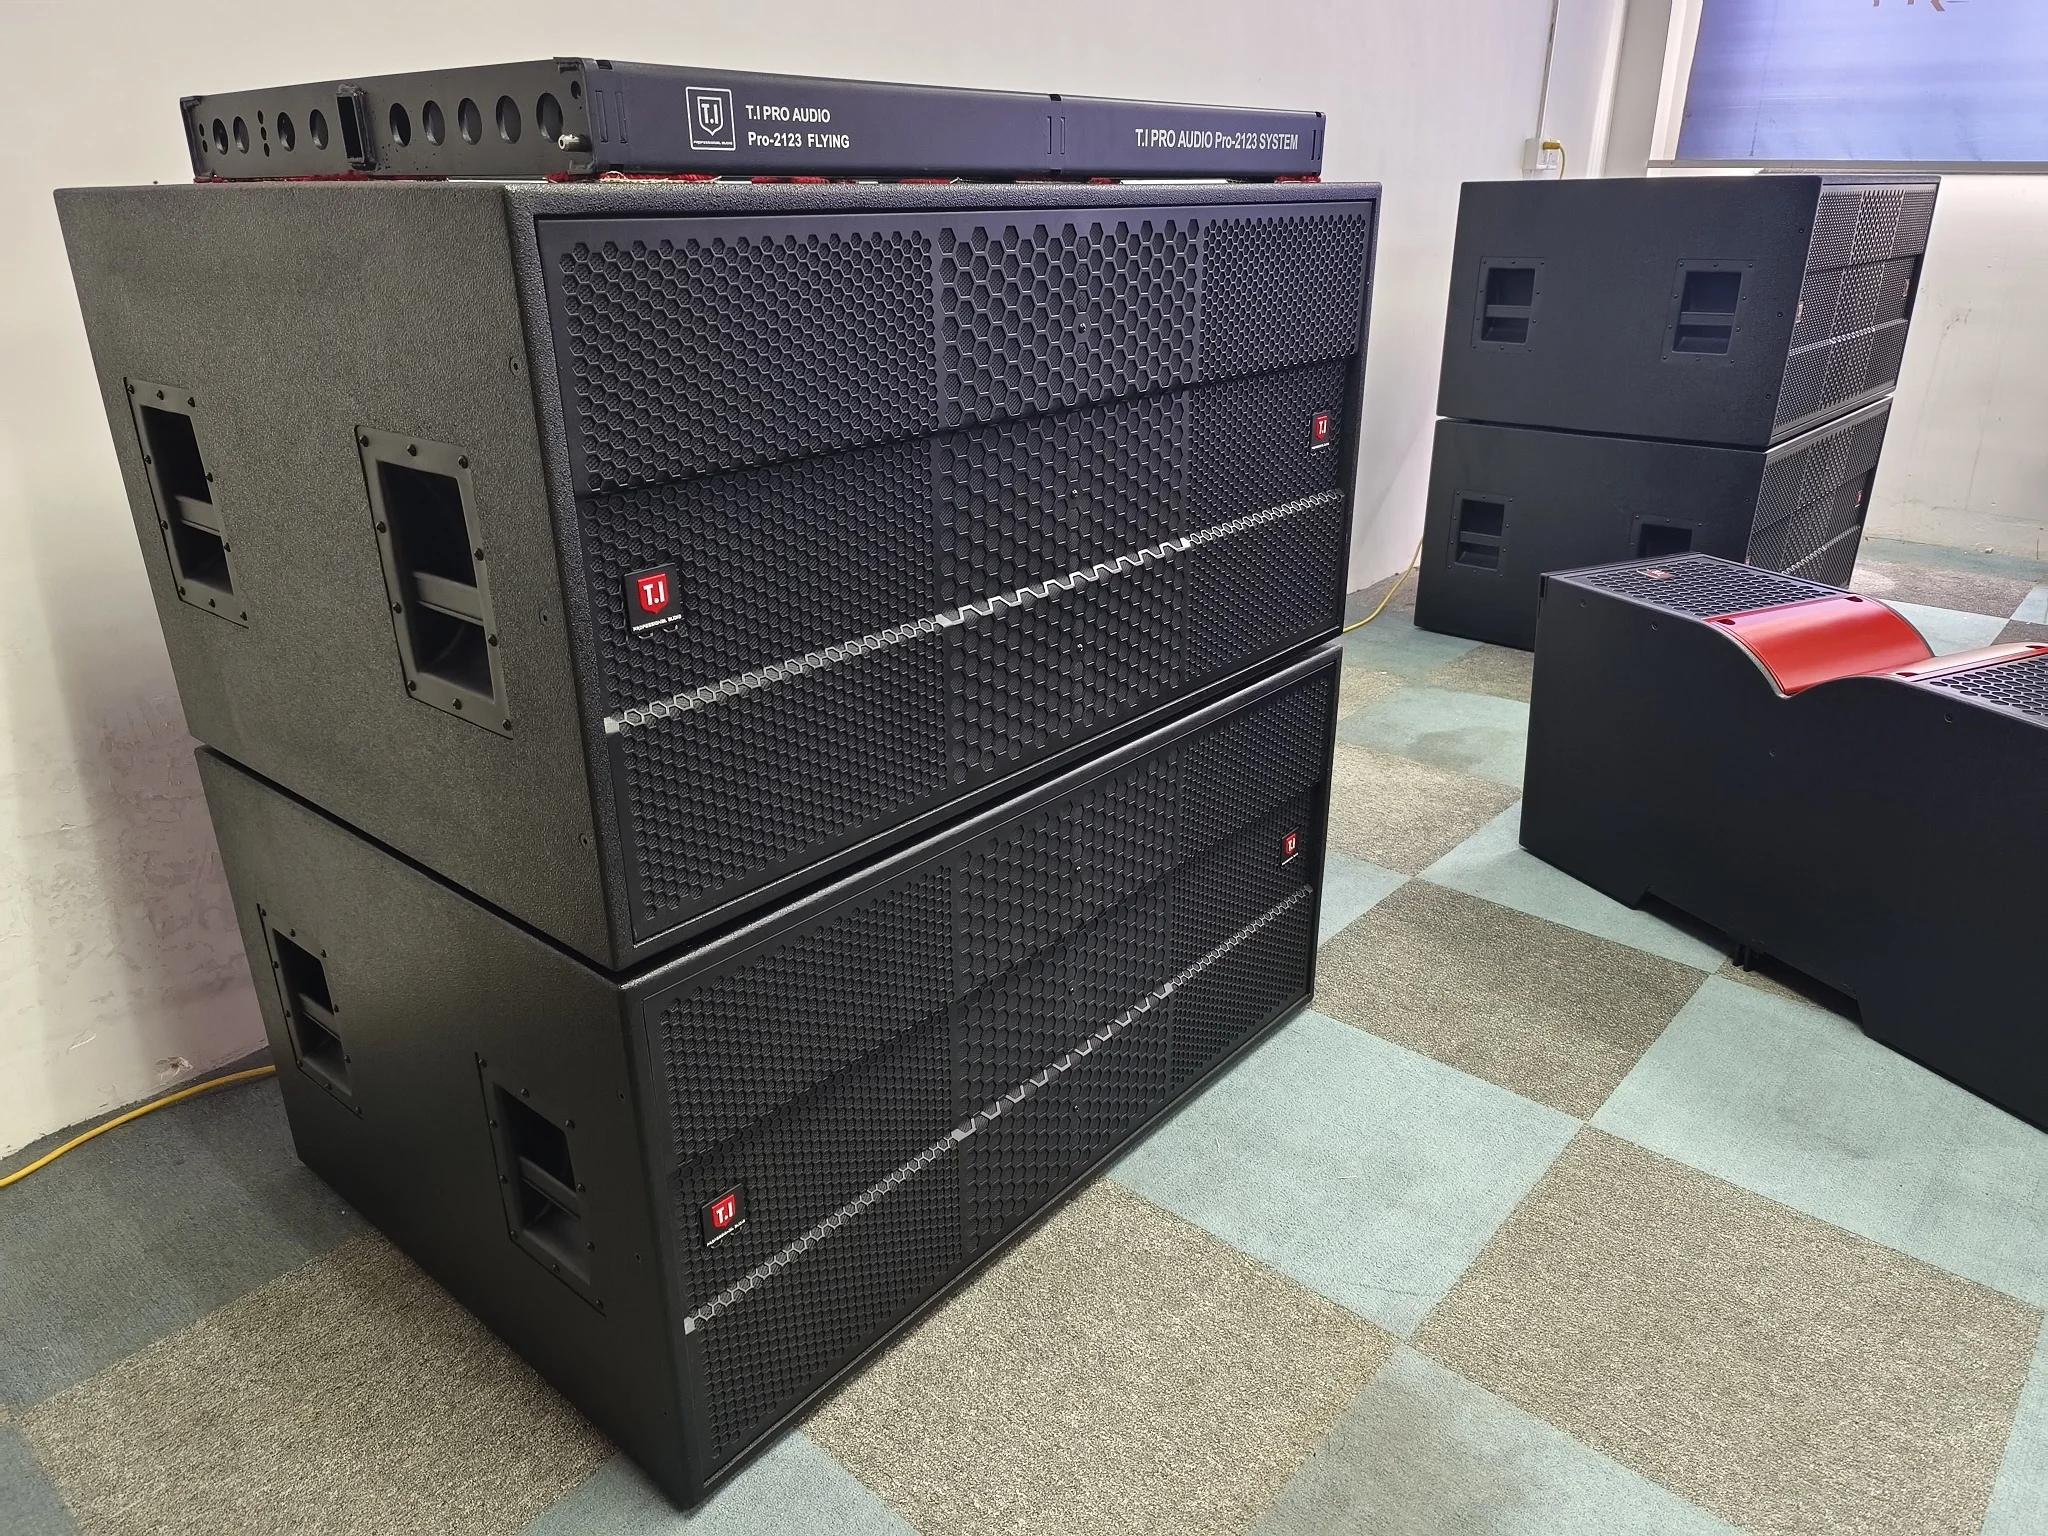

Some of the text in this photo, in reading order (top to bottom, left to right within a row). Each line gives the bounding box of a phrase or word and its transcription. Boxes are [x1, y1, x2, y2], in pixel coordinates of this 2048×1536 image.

[745, 104, 831, 123] T.I PRO AUDIO
[747, 131, 850, 149] Pro-2123 FLYING
[1135, 128, 1298, 151] T.I PRO AUDIO Pro-2123 SYSTEM
[643, 580, 665, 606] T.I
[715, 1201, 734, 1224] T.I
